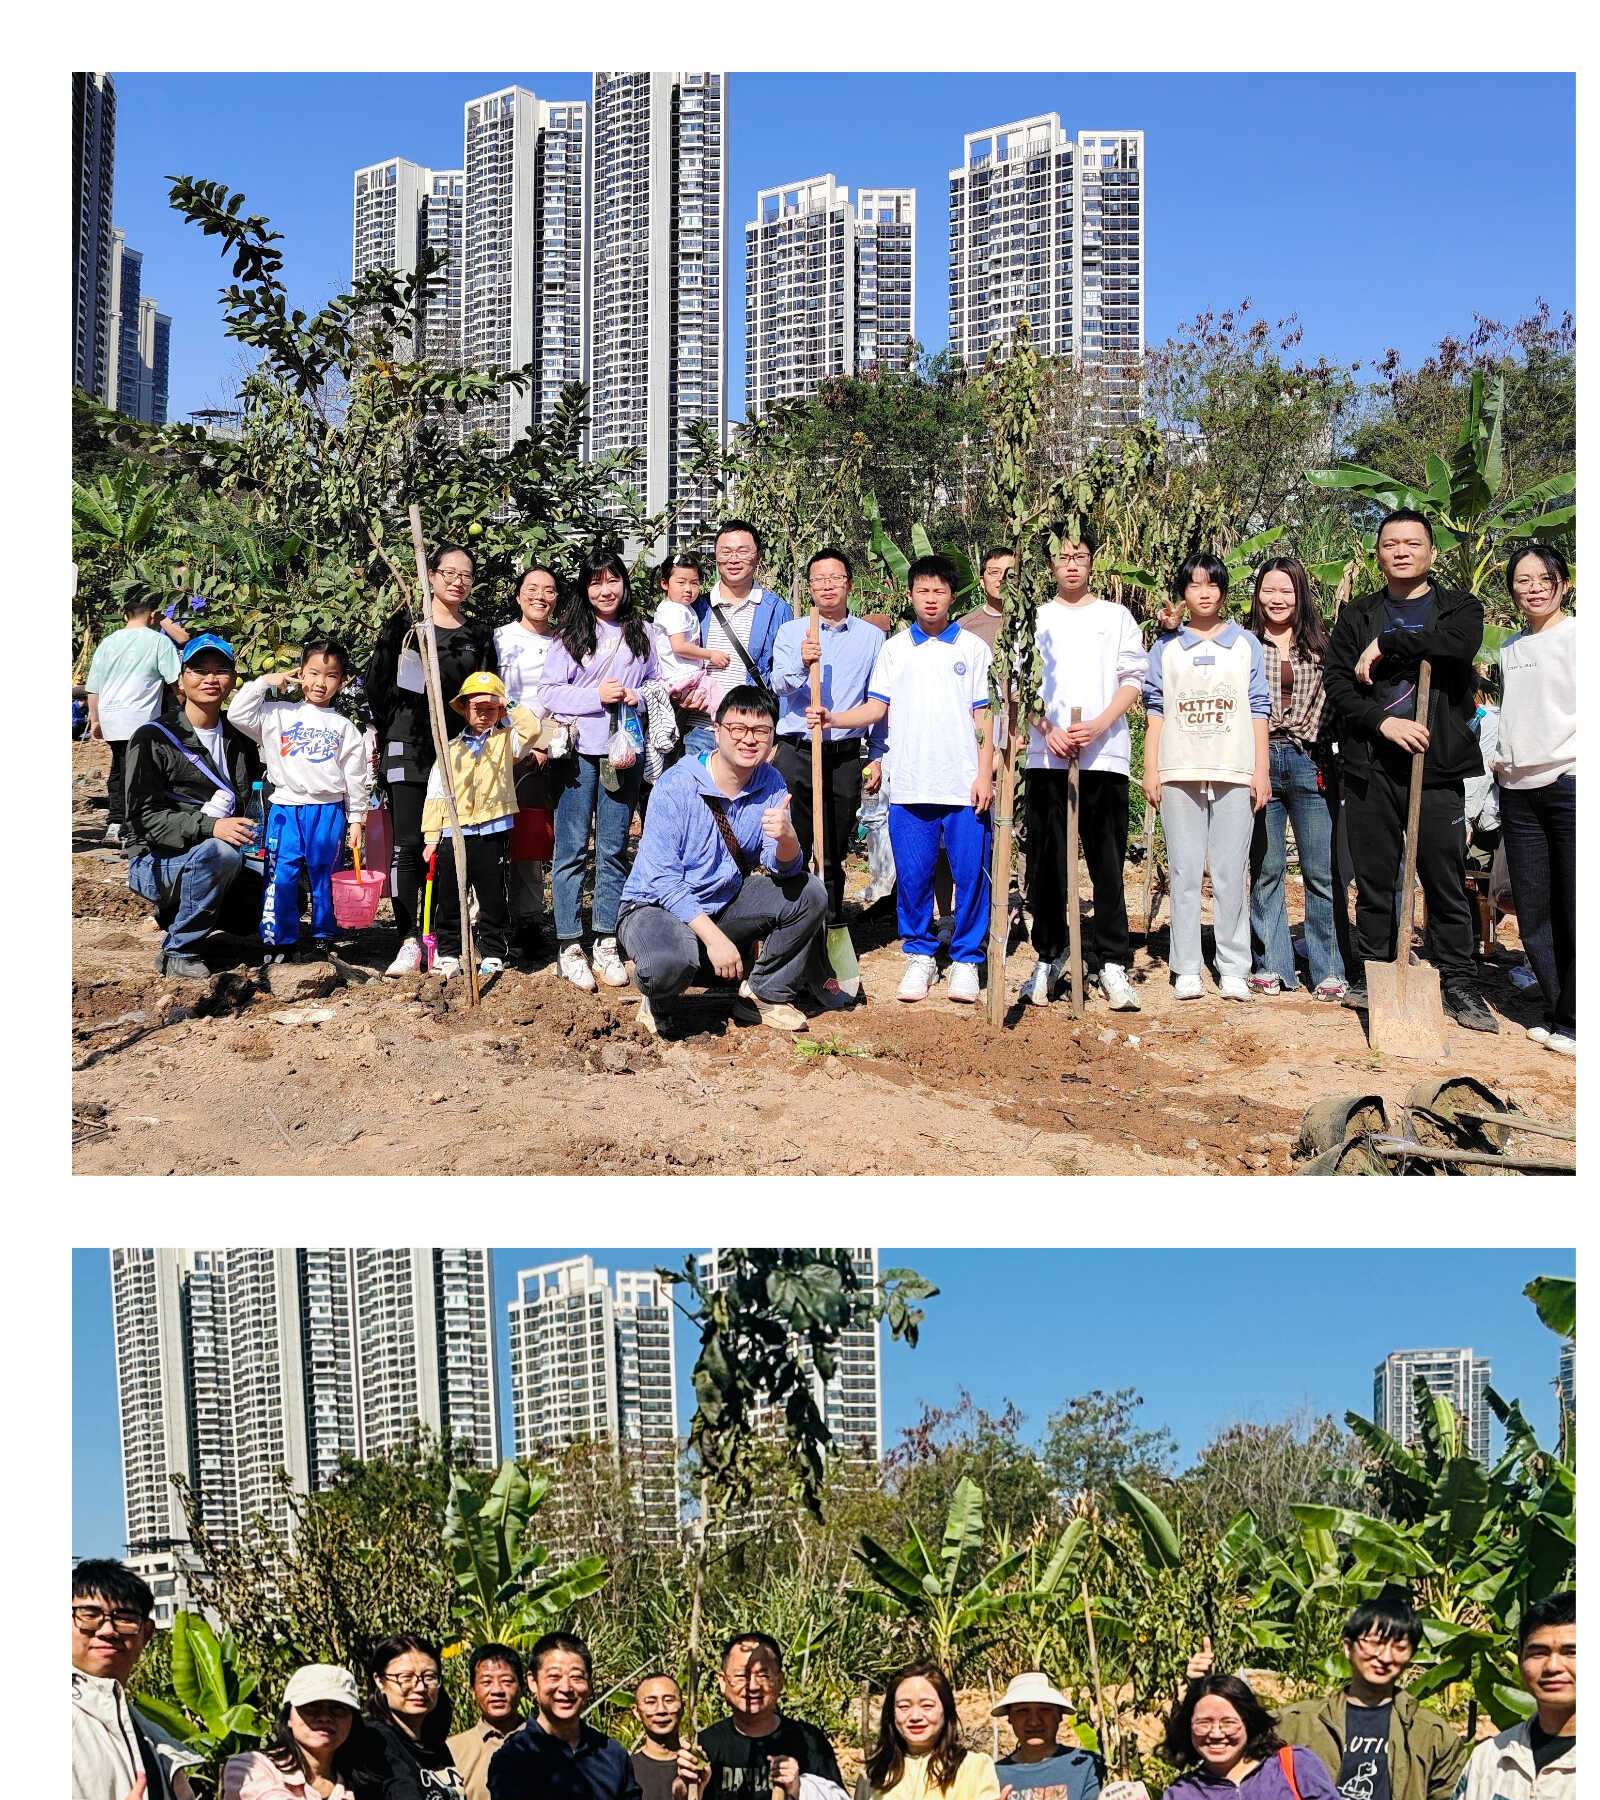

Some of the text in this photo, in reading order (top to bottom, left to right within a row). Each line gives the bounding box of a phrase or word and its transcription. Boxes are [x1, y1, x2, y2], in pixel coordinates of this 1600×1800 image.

[1179, 698, 1234, 712] KITTEN
[1187, 711, 1224, 724] CUTE
[1343, 1736, 1390, 1754] UTI
